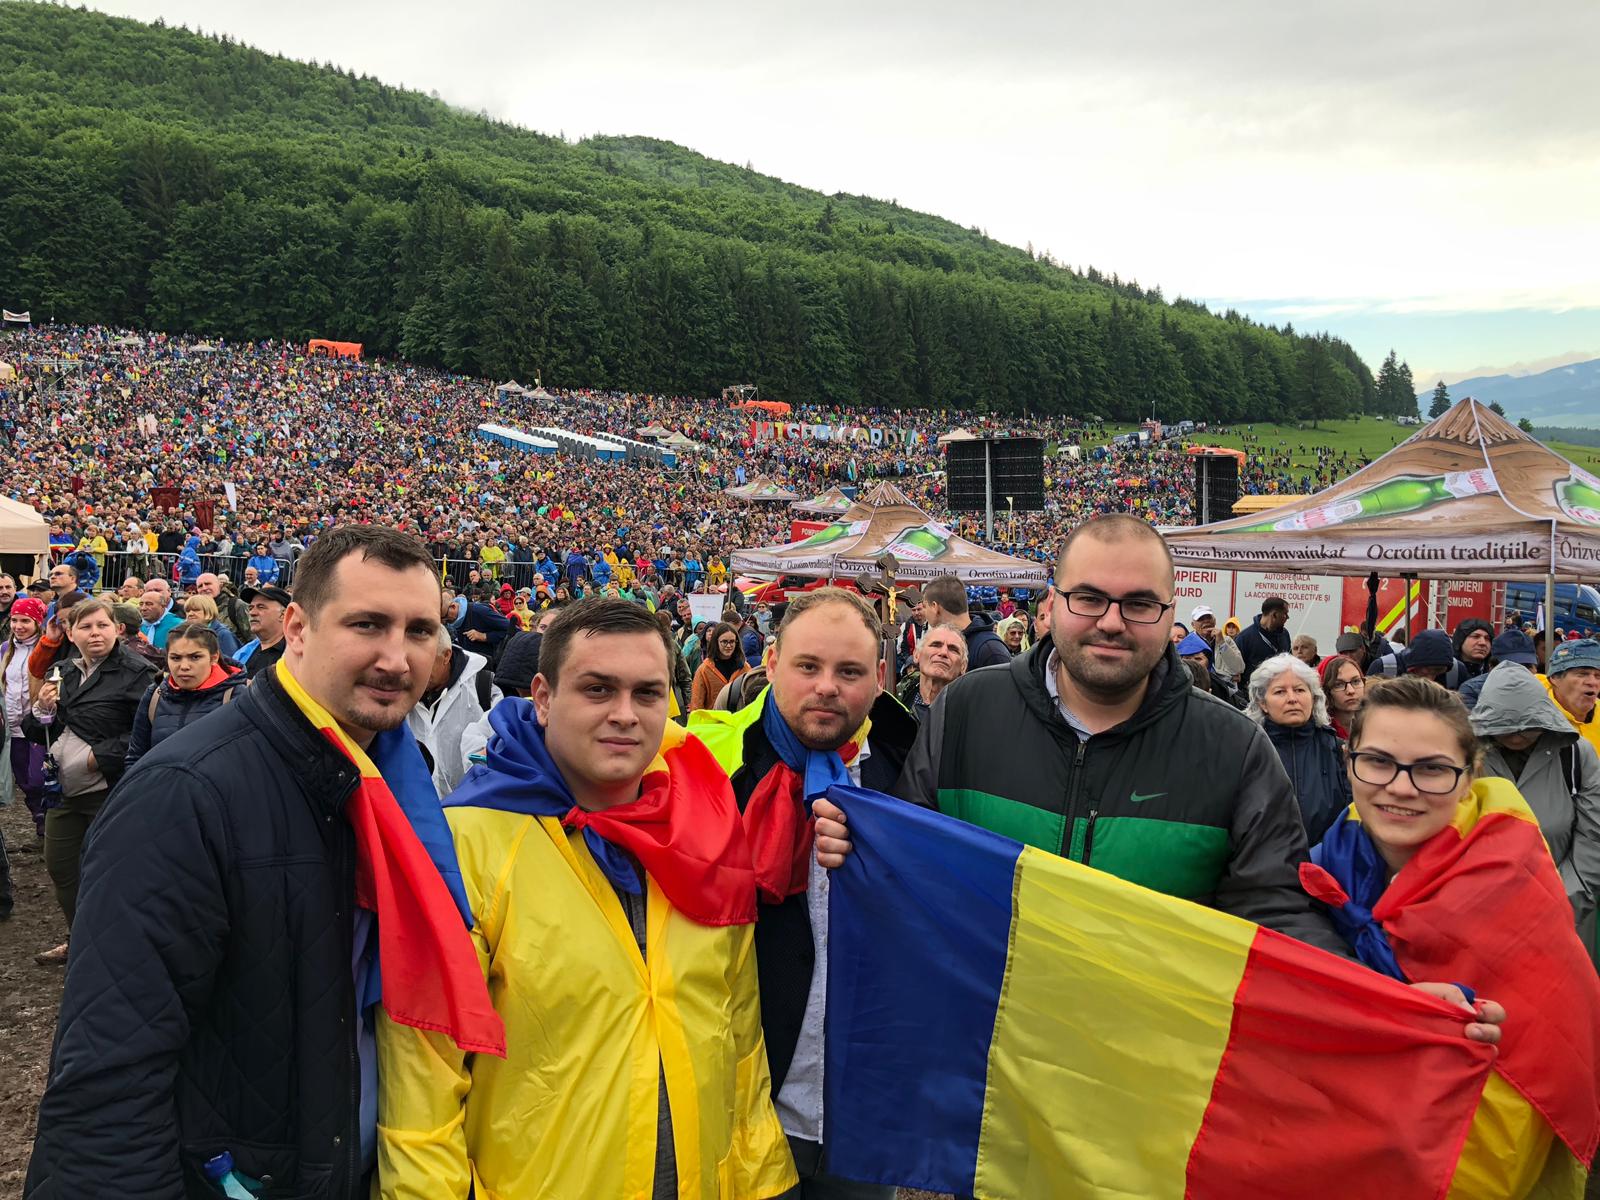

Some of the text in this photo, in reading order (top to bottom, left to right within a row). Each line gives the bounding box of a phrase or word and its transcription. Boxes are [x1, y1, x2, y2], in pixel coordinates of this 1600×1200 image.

[1366, 541, 1541, 563] Ocrotim tradițiile
[1254, 582, 1279, 590] PENTRU
[1447, 597, 1474, 608] SMURD
